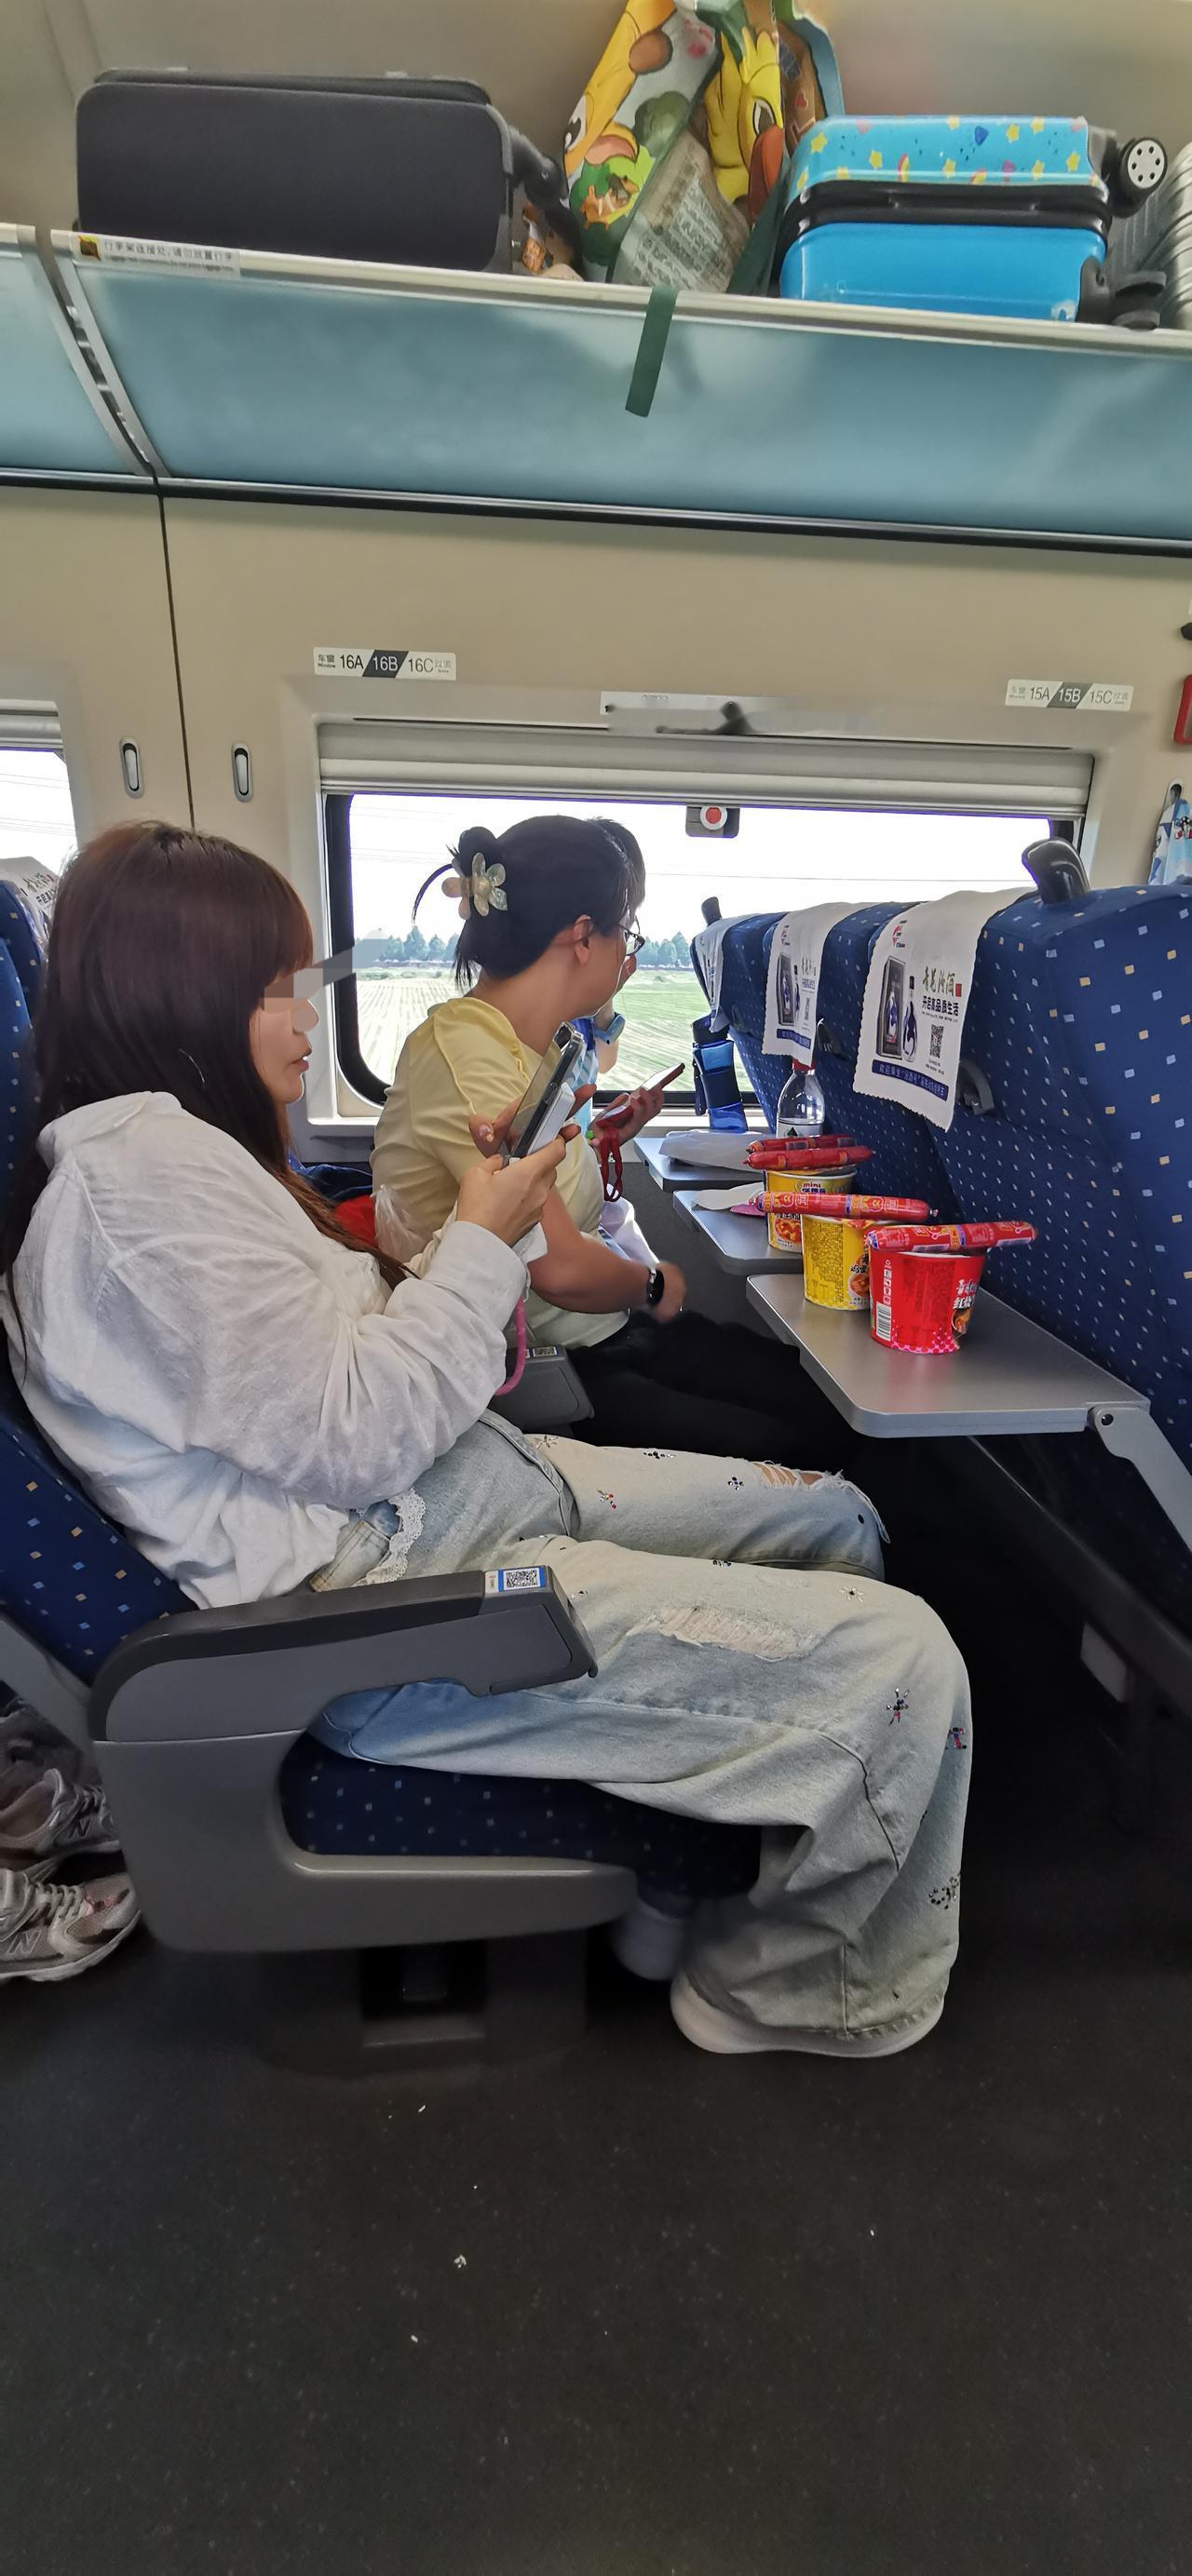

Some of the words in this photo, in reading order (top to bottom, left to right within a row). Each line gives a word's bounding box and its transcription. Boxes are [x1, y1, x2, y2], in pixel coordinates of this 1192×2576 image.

[340, 654, 364, 669] 16A
[372, 655, 399, 671] 16B
[408, 657, 434, 673] 16C
[1030, 687, 1050, 701] 15A
[1058, 688, 1081, 703] 15B
[1090, 690, 1113, 705] 15C
[922, 995, 959, 1017] 开启高品质生活
